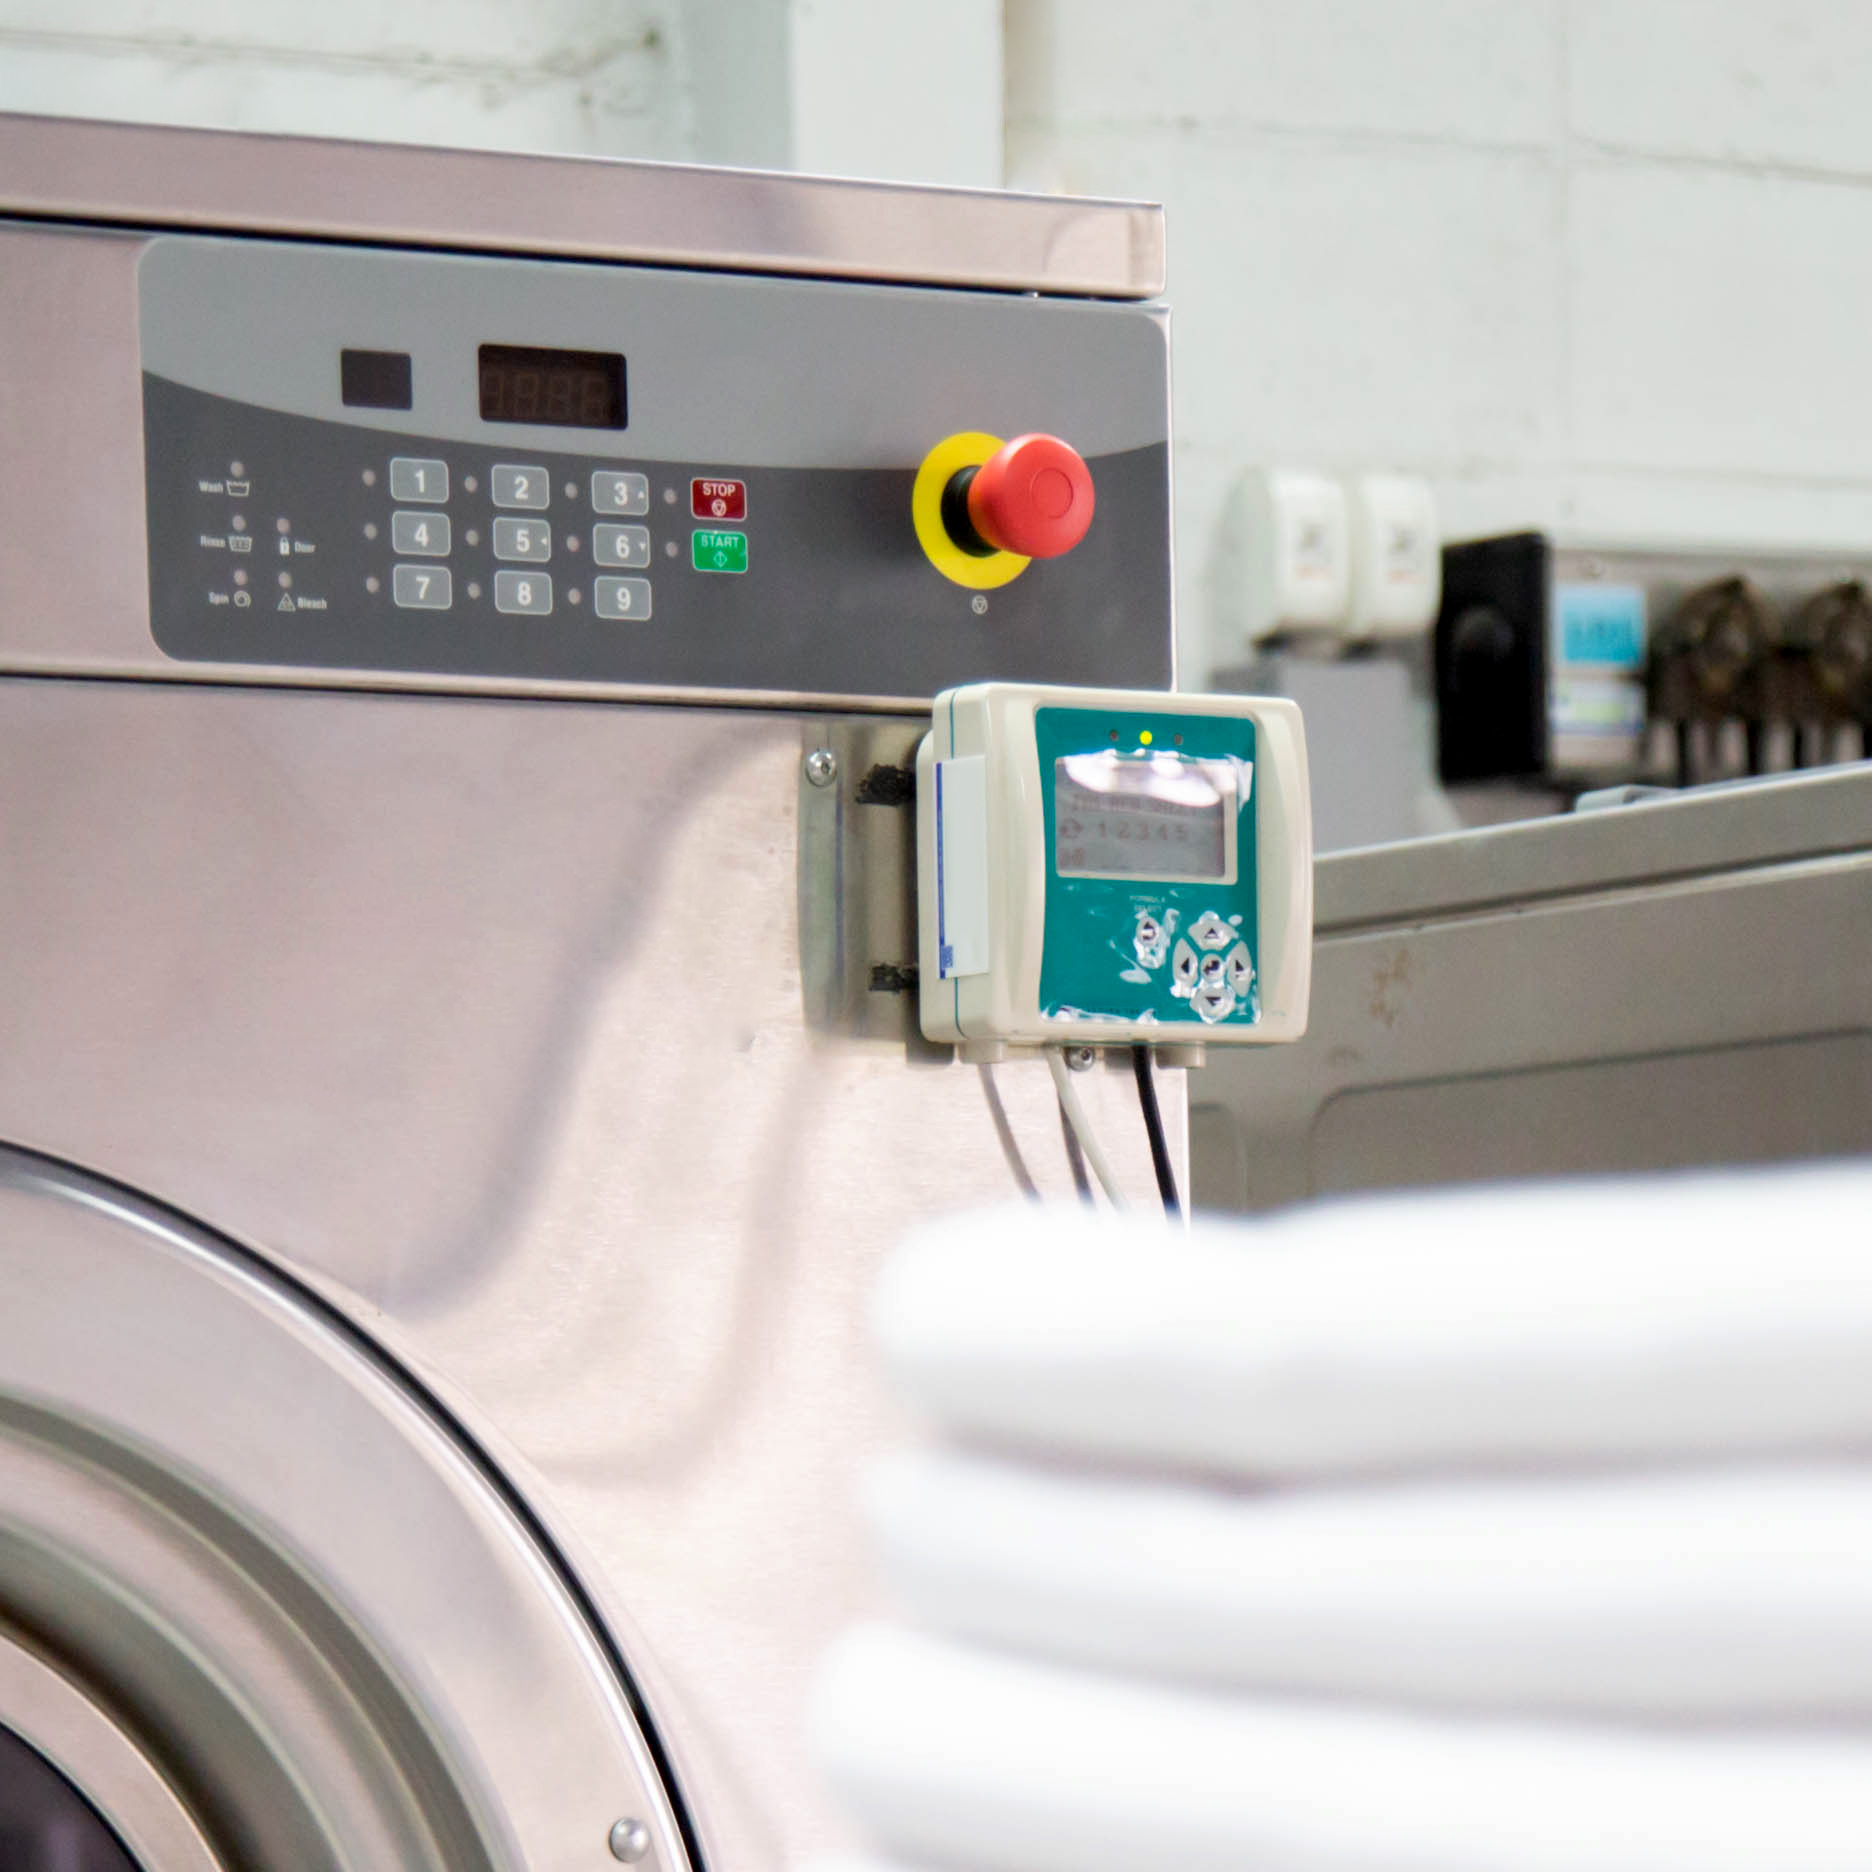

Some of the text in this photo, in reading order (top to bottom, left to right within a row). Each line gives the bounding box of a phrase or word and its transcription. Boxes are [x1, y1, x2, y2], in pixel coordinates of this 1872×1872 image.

[198, 480, 224, 493] Wash
[415, 469, 426, 493] 1
[514, 475, 529, 500] 2
[702, 482, 736, 497] STOP
[613, 481, 628, 506] 3
[414, 522, 429, 547] 4
[515, 529, 530, 553] 5
[615, 534, 630, 559] 6
[700, 535, 739, 549] START
[415, 575, 430, 600] 7
[517, 581, 532, 606] 8
[616, 587, 631, 611] 9
[297, 596, 328, 610] Bleach
